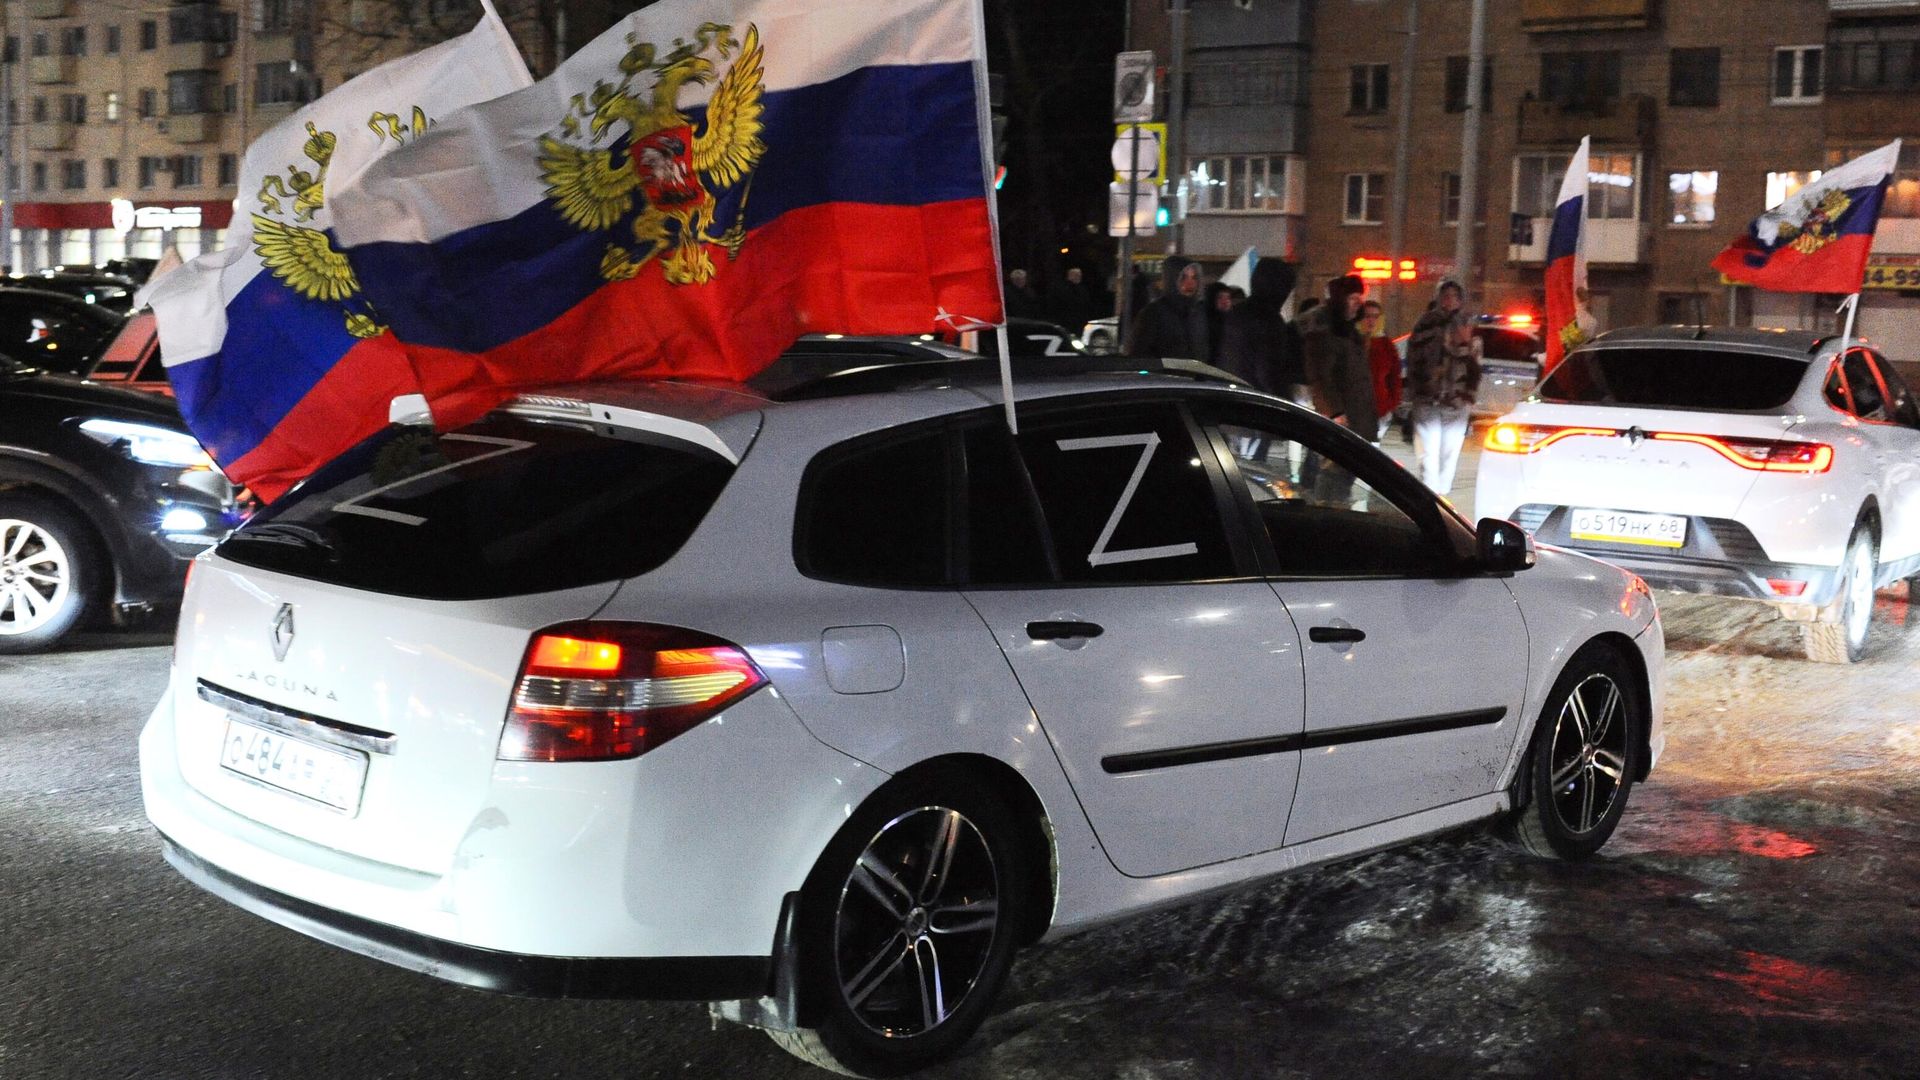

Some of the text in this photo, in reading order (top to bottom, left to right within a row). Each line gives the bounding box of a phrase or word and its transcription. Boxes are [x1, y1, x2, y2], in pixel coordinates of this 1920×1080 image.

[1026, 334, 1080, 356] Z
[332, 433, 537, 526] Z
[1056, 431, 1198, 568] Z
